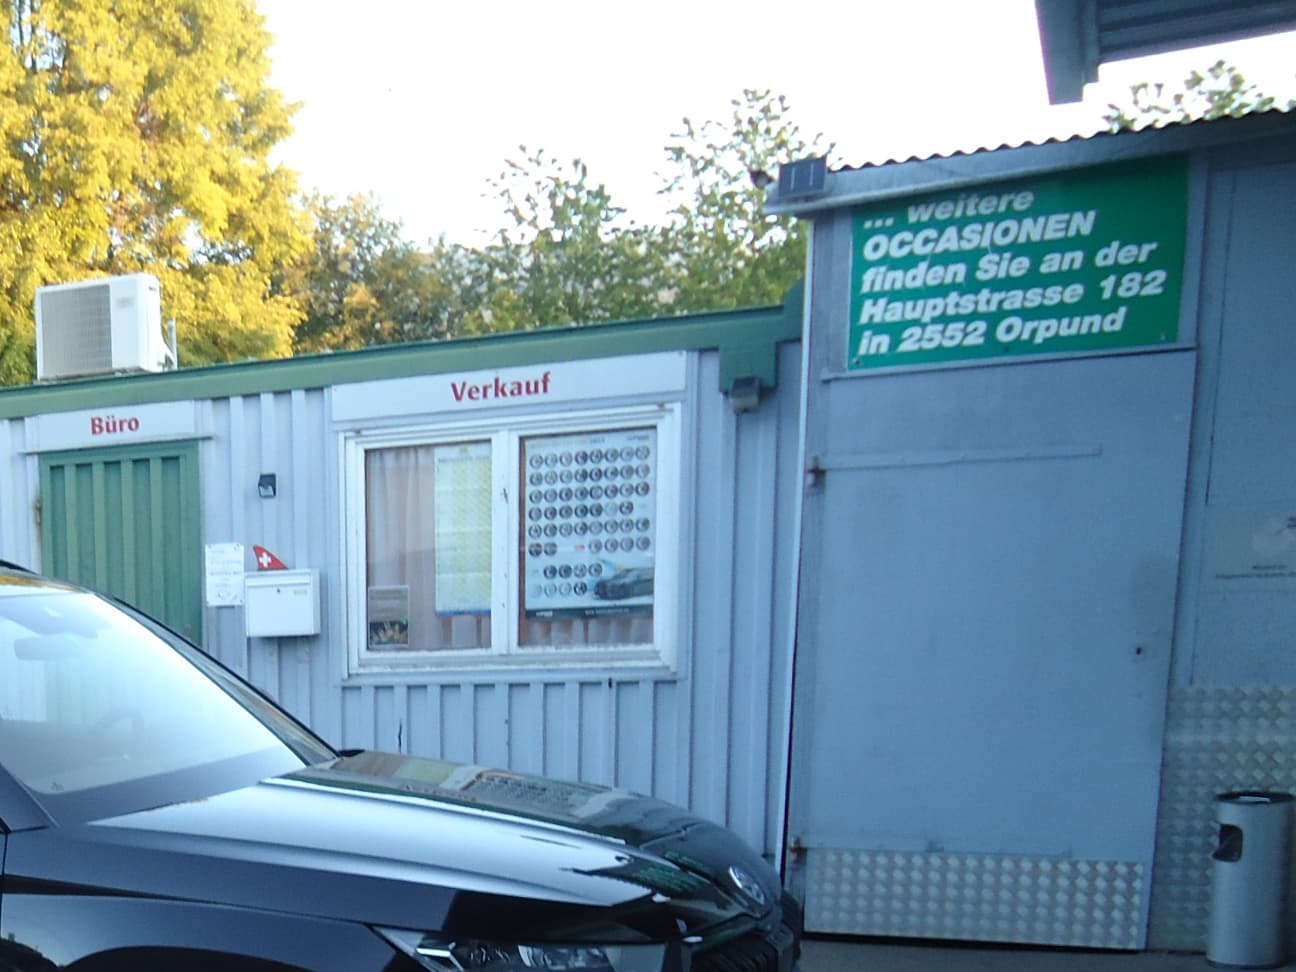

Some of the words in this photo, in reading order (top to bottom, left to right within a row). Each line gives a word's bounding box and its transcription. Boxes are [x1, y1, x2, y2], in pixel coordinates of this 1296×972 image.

[908, 191, 1035, 224] weitere
[863, 209, 1097, 261] OCCASIONEN
[860, 260, 967, 294] finden
[975, 252, 1031, 281] Sie
[1039, 250, 1084, 274] an
[1094, 240, 1159, 268] der
[859, 283, 1085, 326] Hauptstrasse
[1100, 269, 1167, 299] 182
[858, 330, 891, 356] in
[896, 320, 988, 352] 2552
[995, 306, 1128, 344] Orpund
[451, 372, 552, 401] Verkauf
[90, 414, 141, 437] Büro
